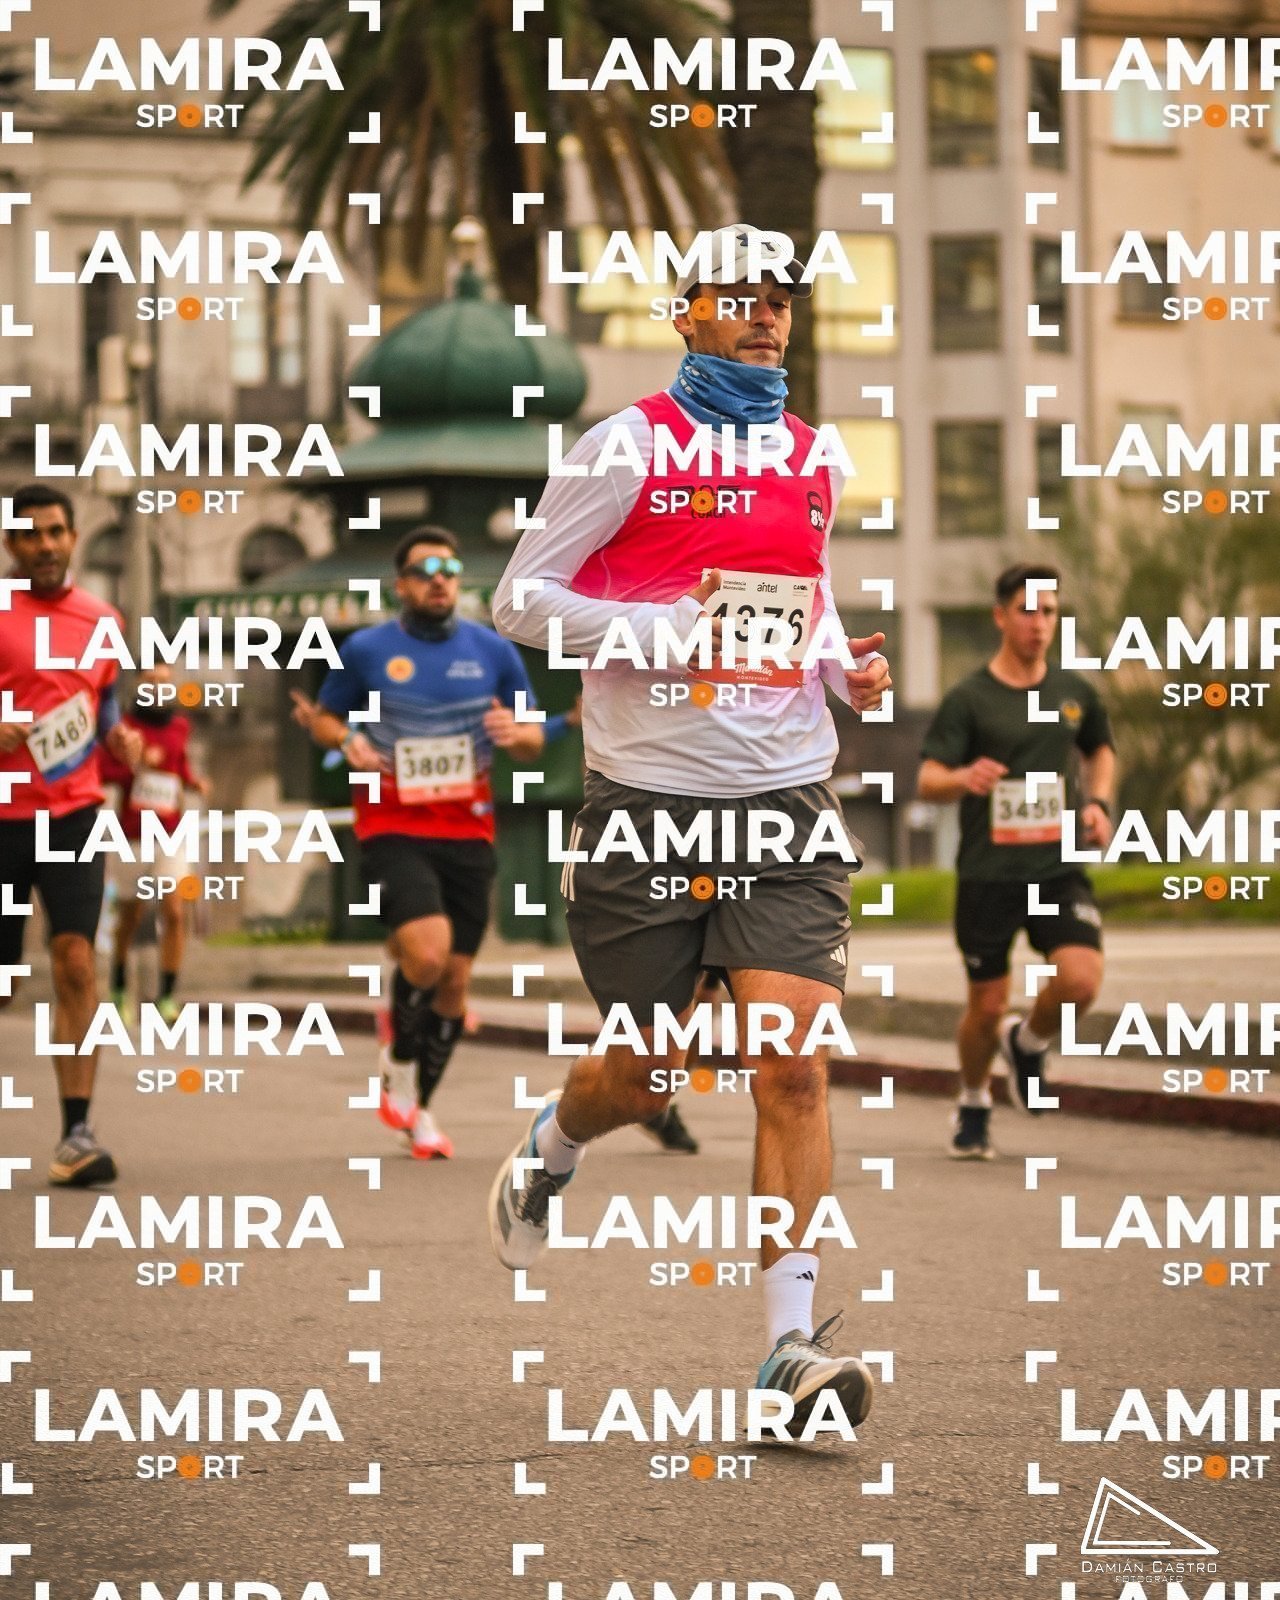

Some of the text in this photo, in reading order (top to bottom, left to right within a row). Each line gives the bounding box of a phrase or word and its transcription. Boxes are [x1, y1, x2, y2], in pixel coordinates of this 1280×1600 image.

[756, 582, 778, 593] antel
[735, 662, 774, 677] Matón
[404, 755, 464, 779] 3807
